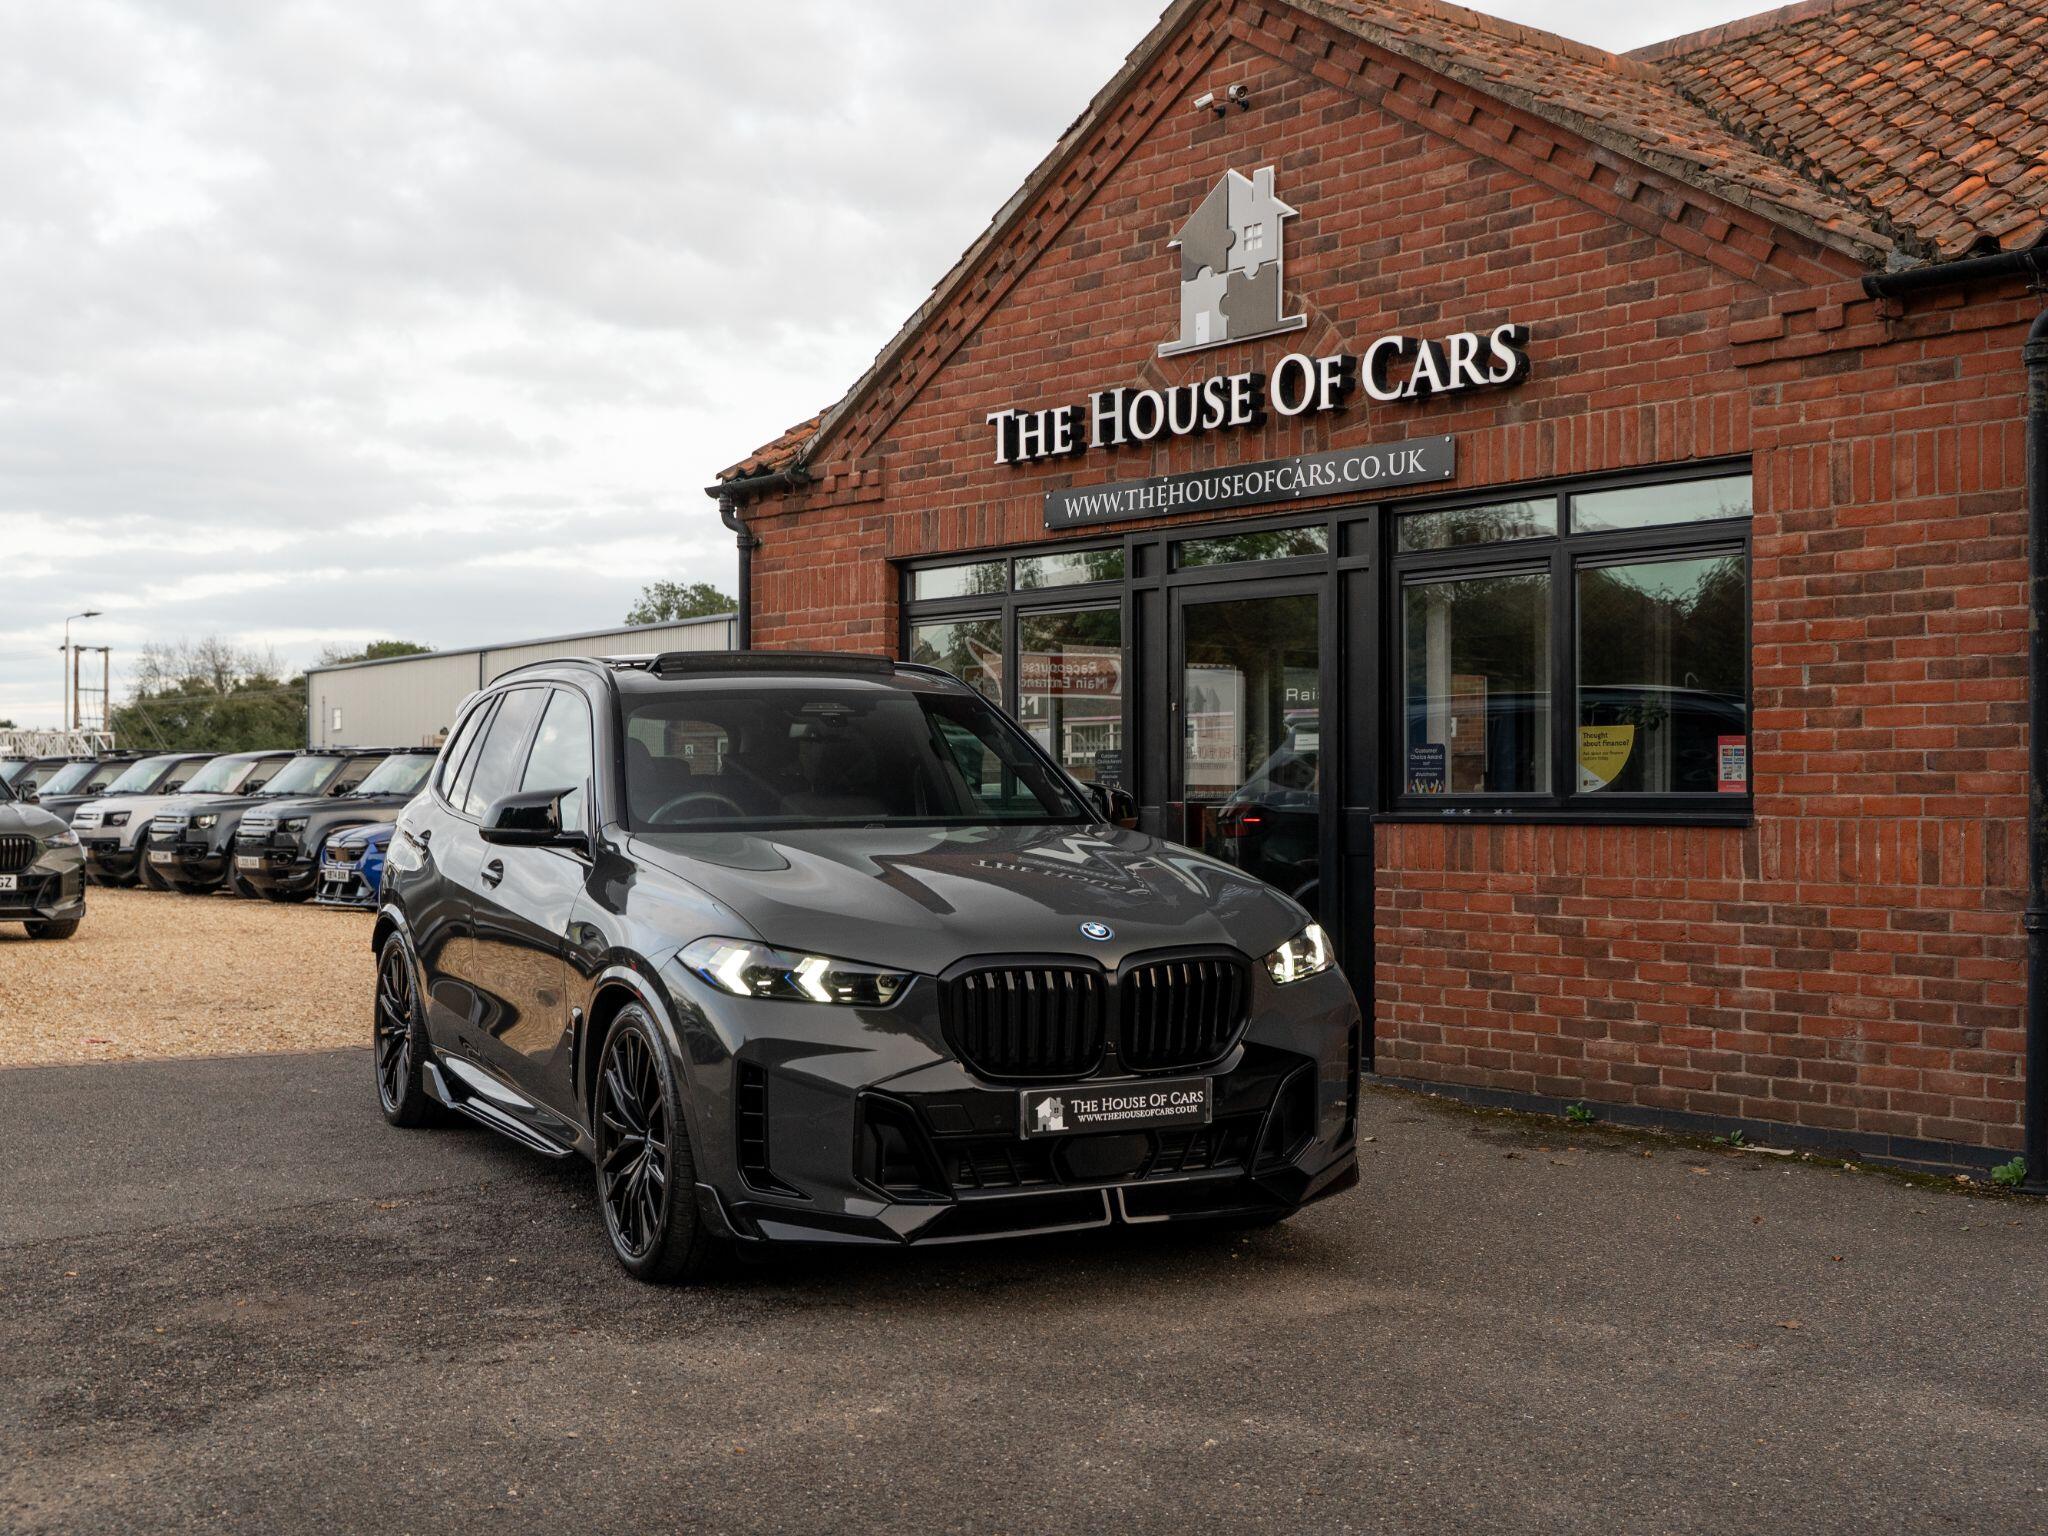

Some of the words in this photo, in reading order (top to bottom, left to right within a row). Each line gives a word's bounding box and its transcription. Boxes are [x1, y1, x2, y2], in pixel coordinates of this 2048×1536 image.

[1064, 448, 1427, 520] WWW.THEHOUSEOFCARS.CO.UK
[1286, 687, 1319, 701] Rai
[1583, 732, 1608, 740] Thought
[1602, 739, 1629, 747] finance?
